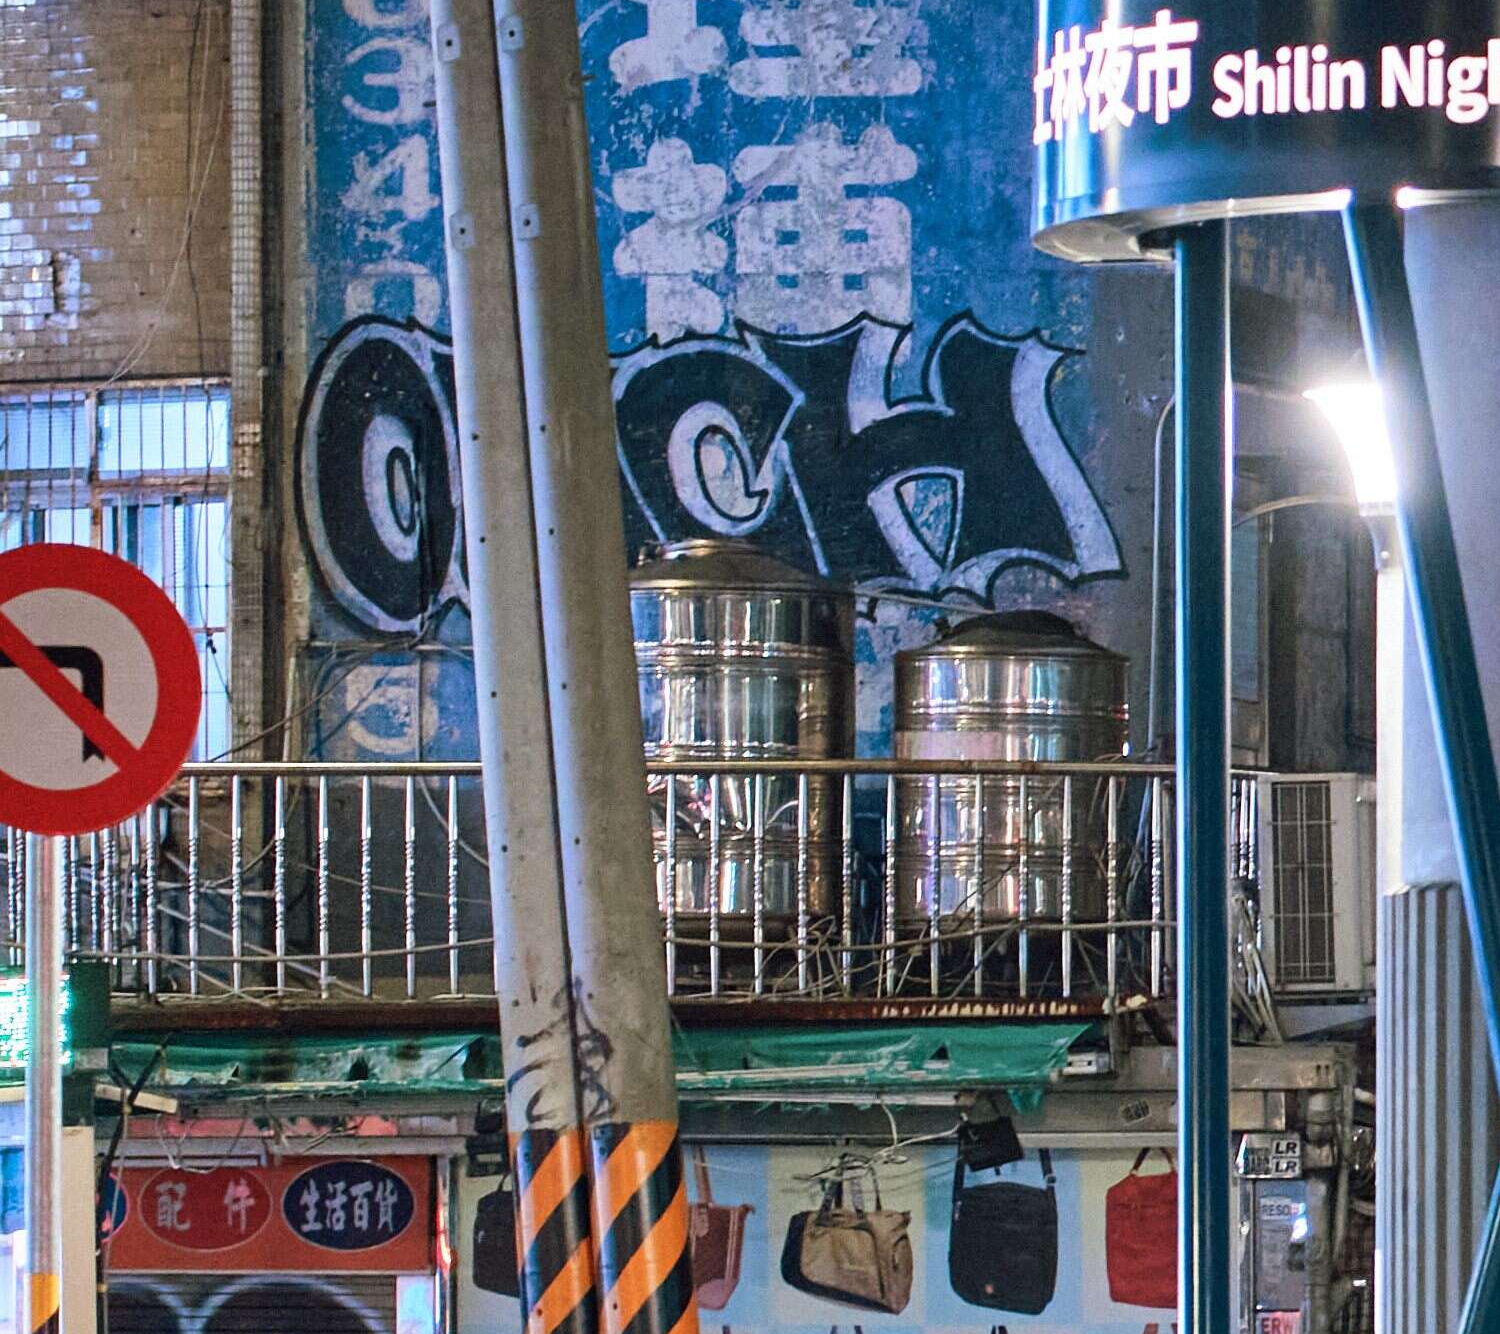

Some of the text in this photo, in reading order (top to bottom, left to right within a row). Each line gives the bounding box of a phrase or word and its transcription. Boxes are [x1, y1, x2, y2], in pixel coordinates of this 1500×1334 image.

[1031, 7, 1199, 147] 士林夜市
[1210, 44, 1367, 120] Shilin
[1274, 1141, 1298, 1155] LR
[1274, 1160, 1298, 1174] LR
[154, 1178, 399, 1234] 配件 生活百貨
